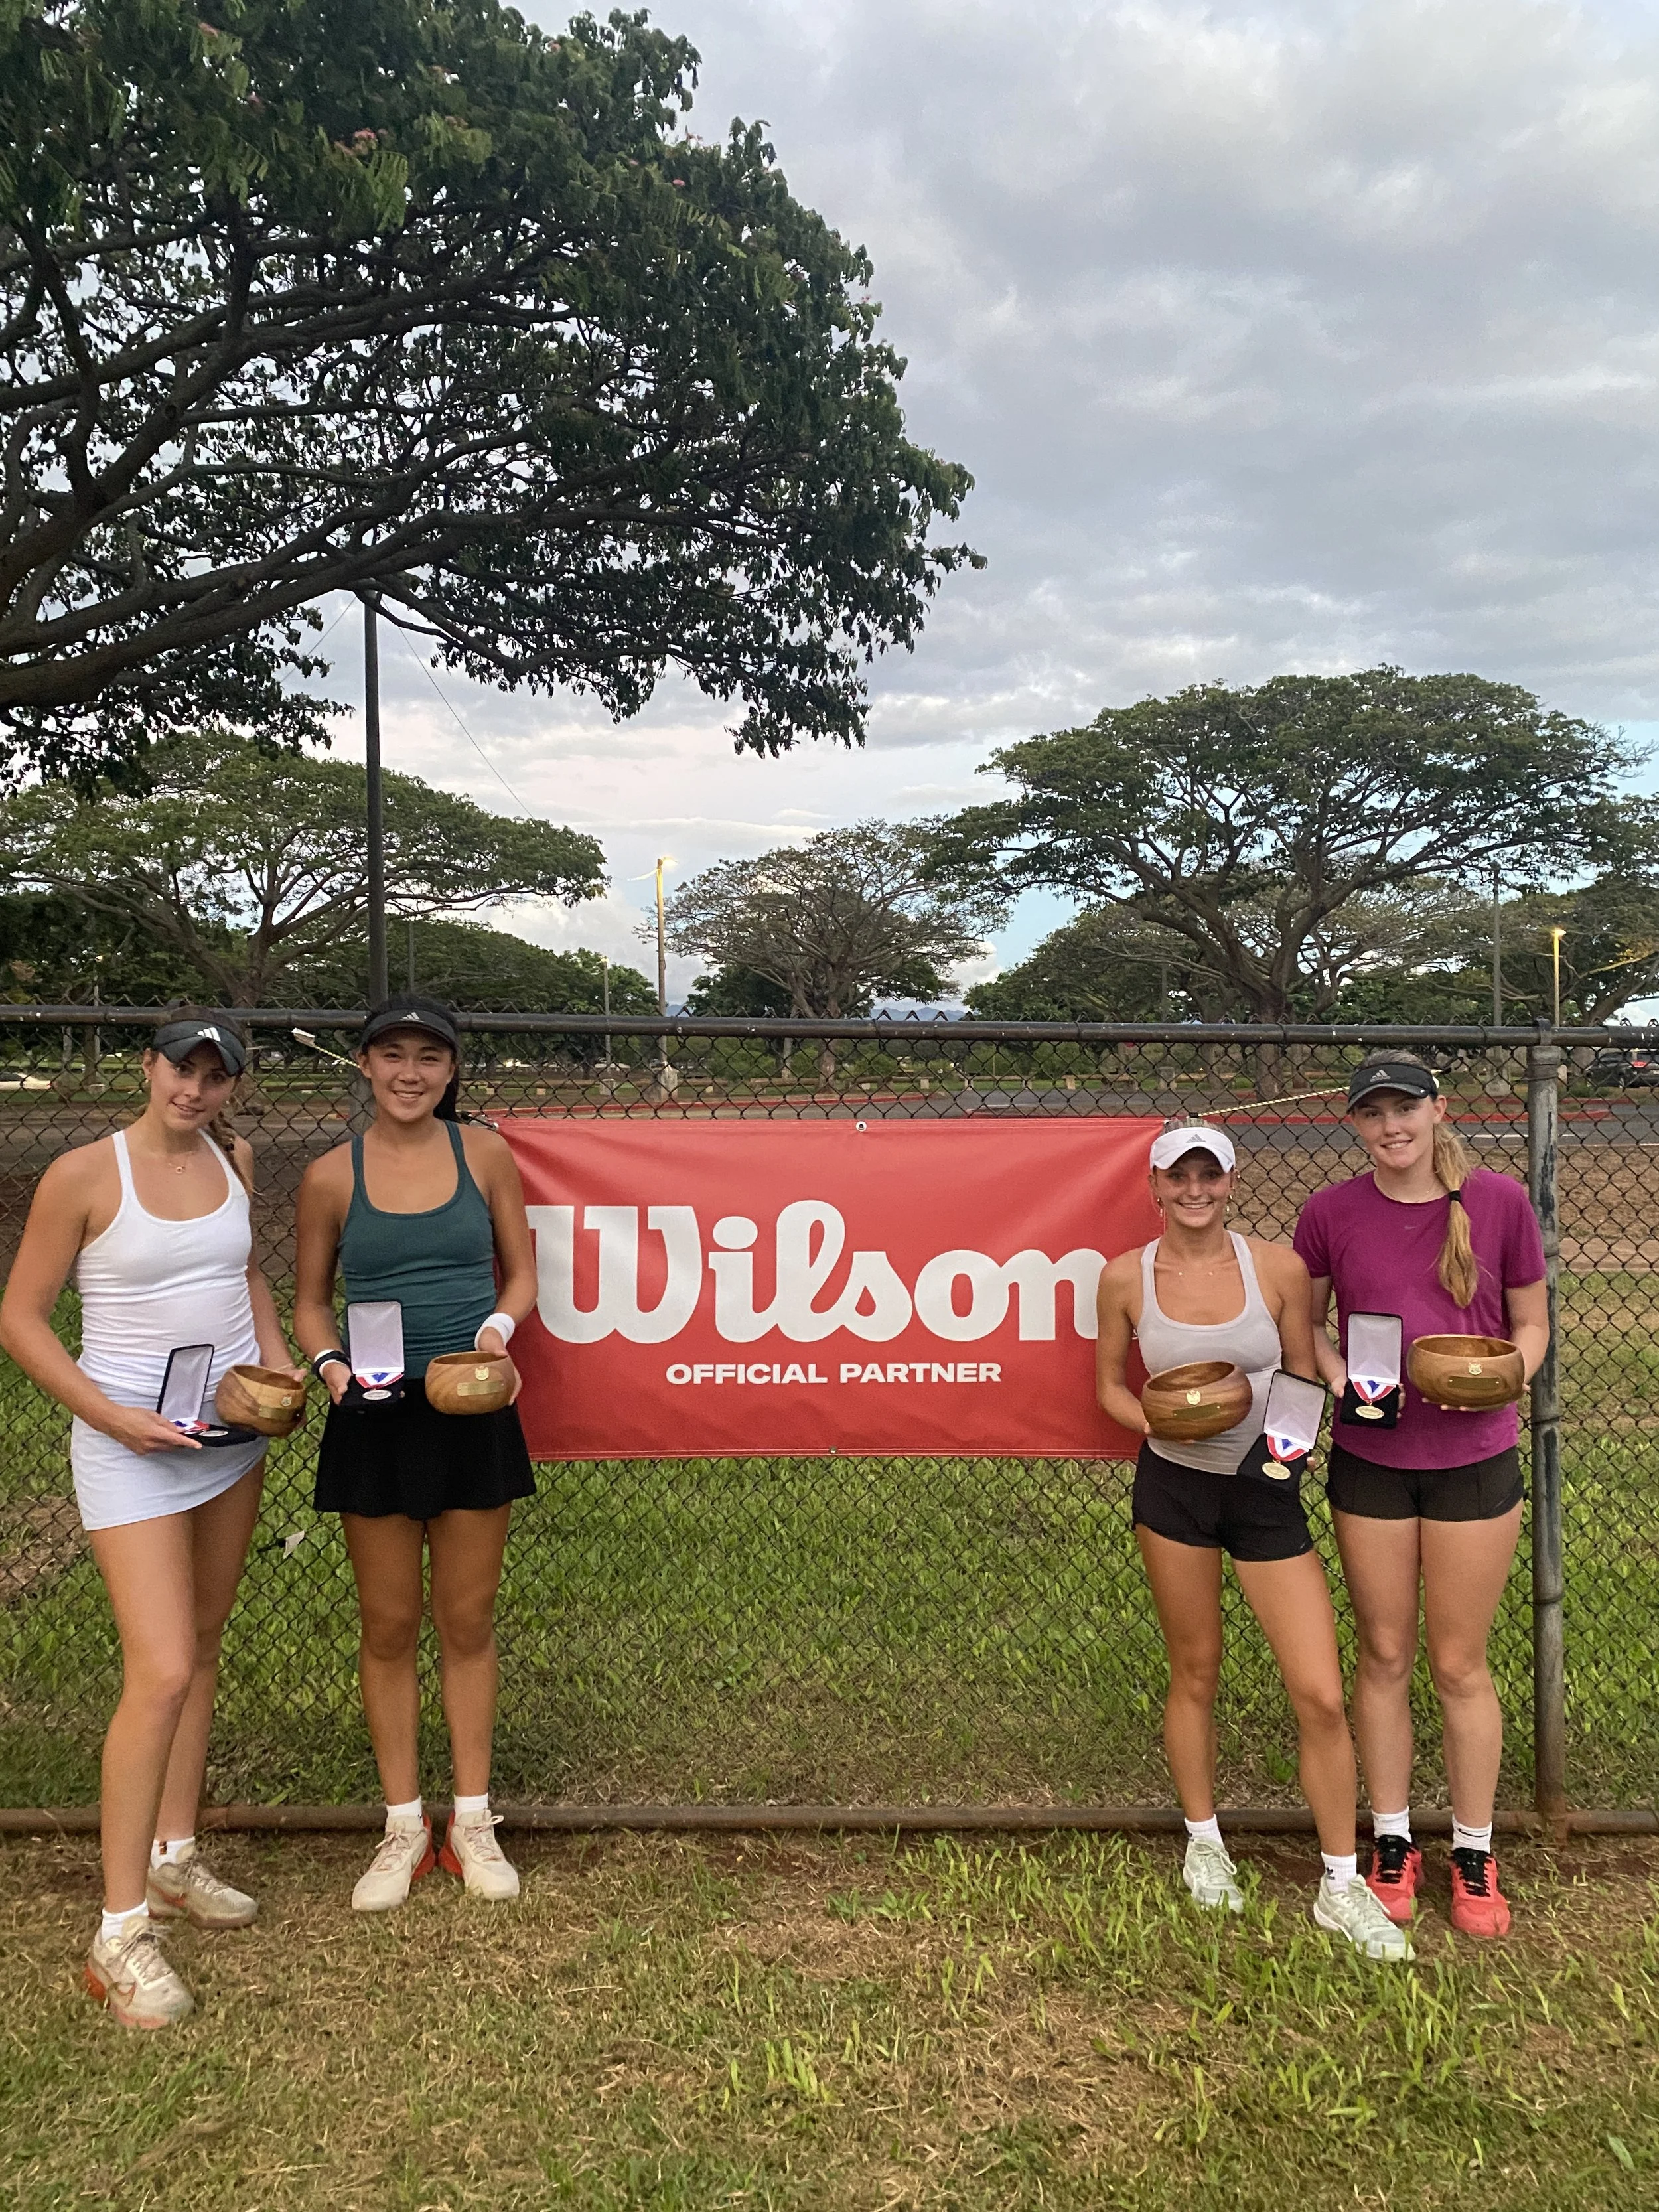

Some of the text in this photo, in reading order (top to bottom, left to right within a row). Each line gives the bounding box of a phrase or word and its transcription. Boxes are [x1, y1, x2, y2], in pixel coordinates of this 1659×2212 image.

[524, 1199, 1108, 1344] Wilson
[666, 1363, 1001, 1385] OFFICIAL PARTNER
